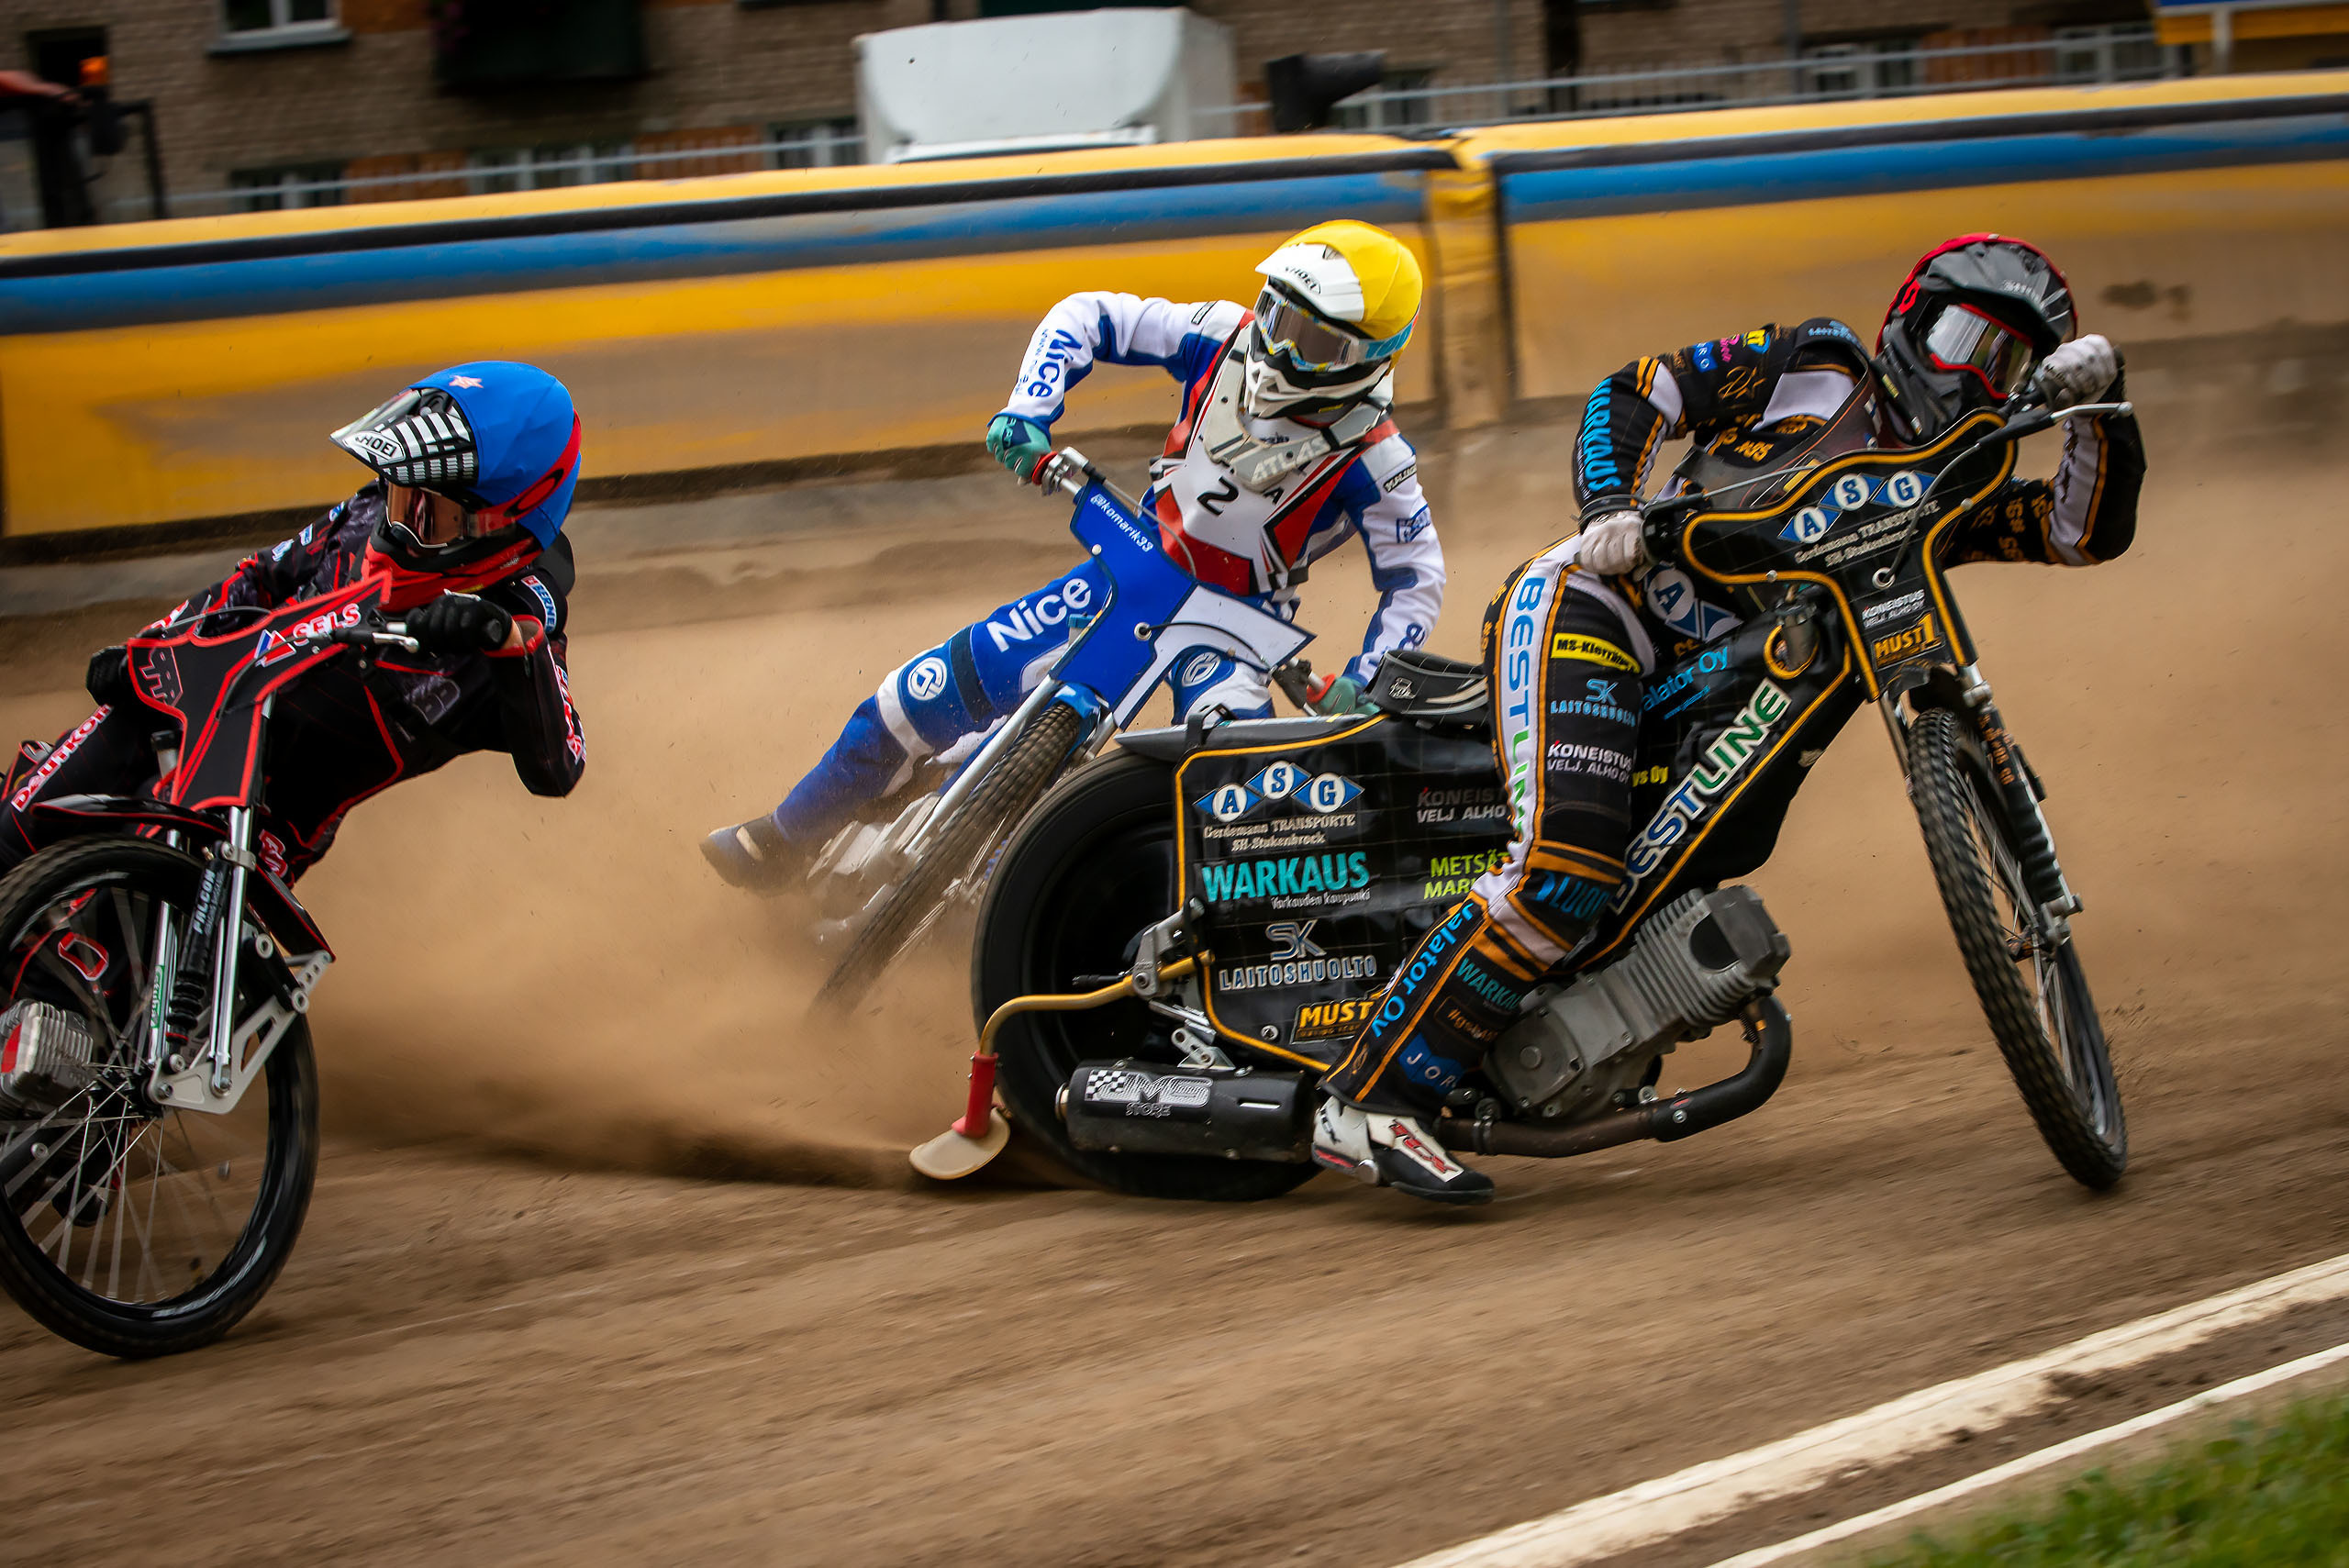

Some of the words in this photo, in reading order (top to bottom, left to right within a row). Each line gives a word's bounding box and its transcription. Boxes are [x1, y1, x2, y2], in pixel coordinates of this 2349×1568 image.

[1028, 329, 1083, 397] Nice
[1197, 475, 1239, 516] 2
[986, 578, 1092, 653] Nice
[1698, 646, 1729, 675] Oy
[1586, 678, 1620, 706] SK
[1547, 740, 1633, 772] KONEISTUS
[1586, 762, 1619, 780] ALHO
[1220, 767, 1338, 815] ASG
[1272, 813, 1356, 831] TRANSPORTE
[1462, 805, 1507, 820] ALHO
[1201, 851, 1371, 903] WARKAUS
[193, 868, 217, 934] FALCON
[1264, 919, 1328, 962] SK
[1403, 902, 1475, 995] Jalator
[1218, 955, 1378, 992] LAITOSHUOLTO
